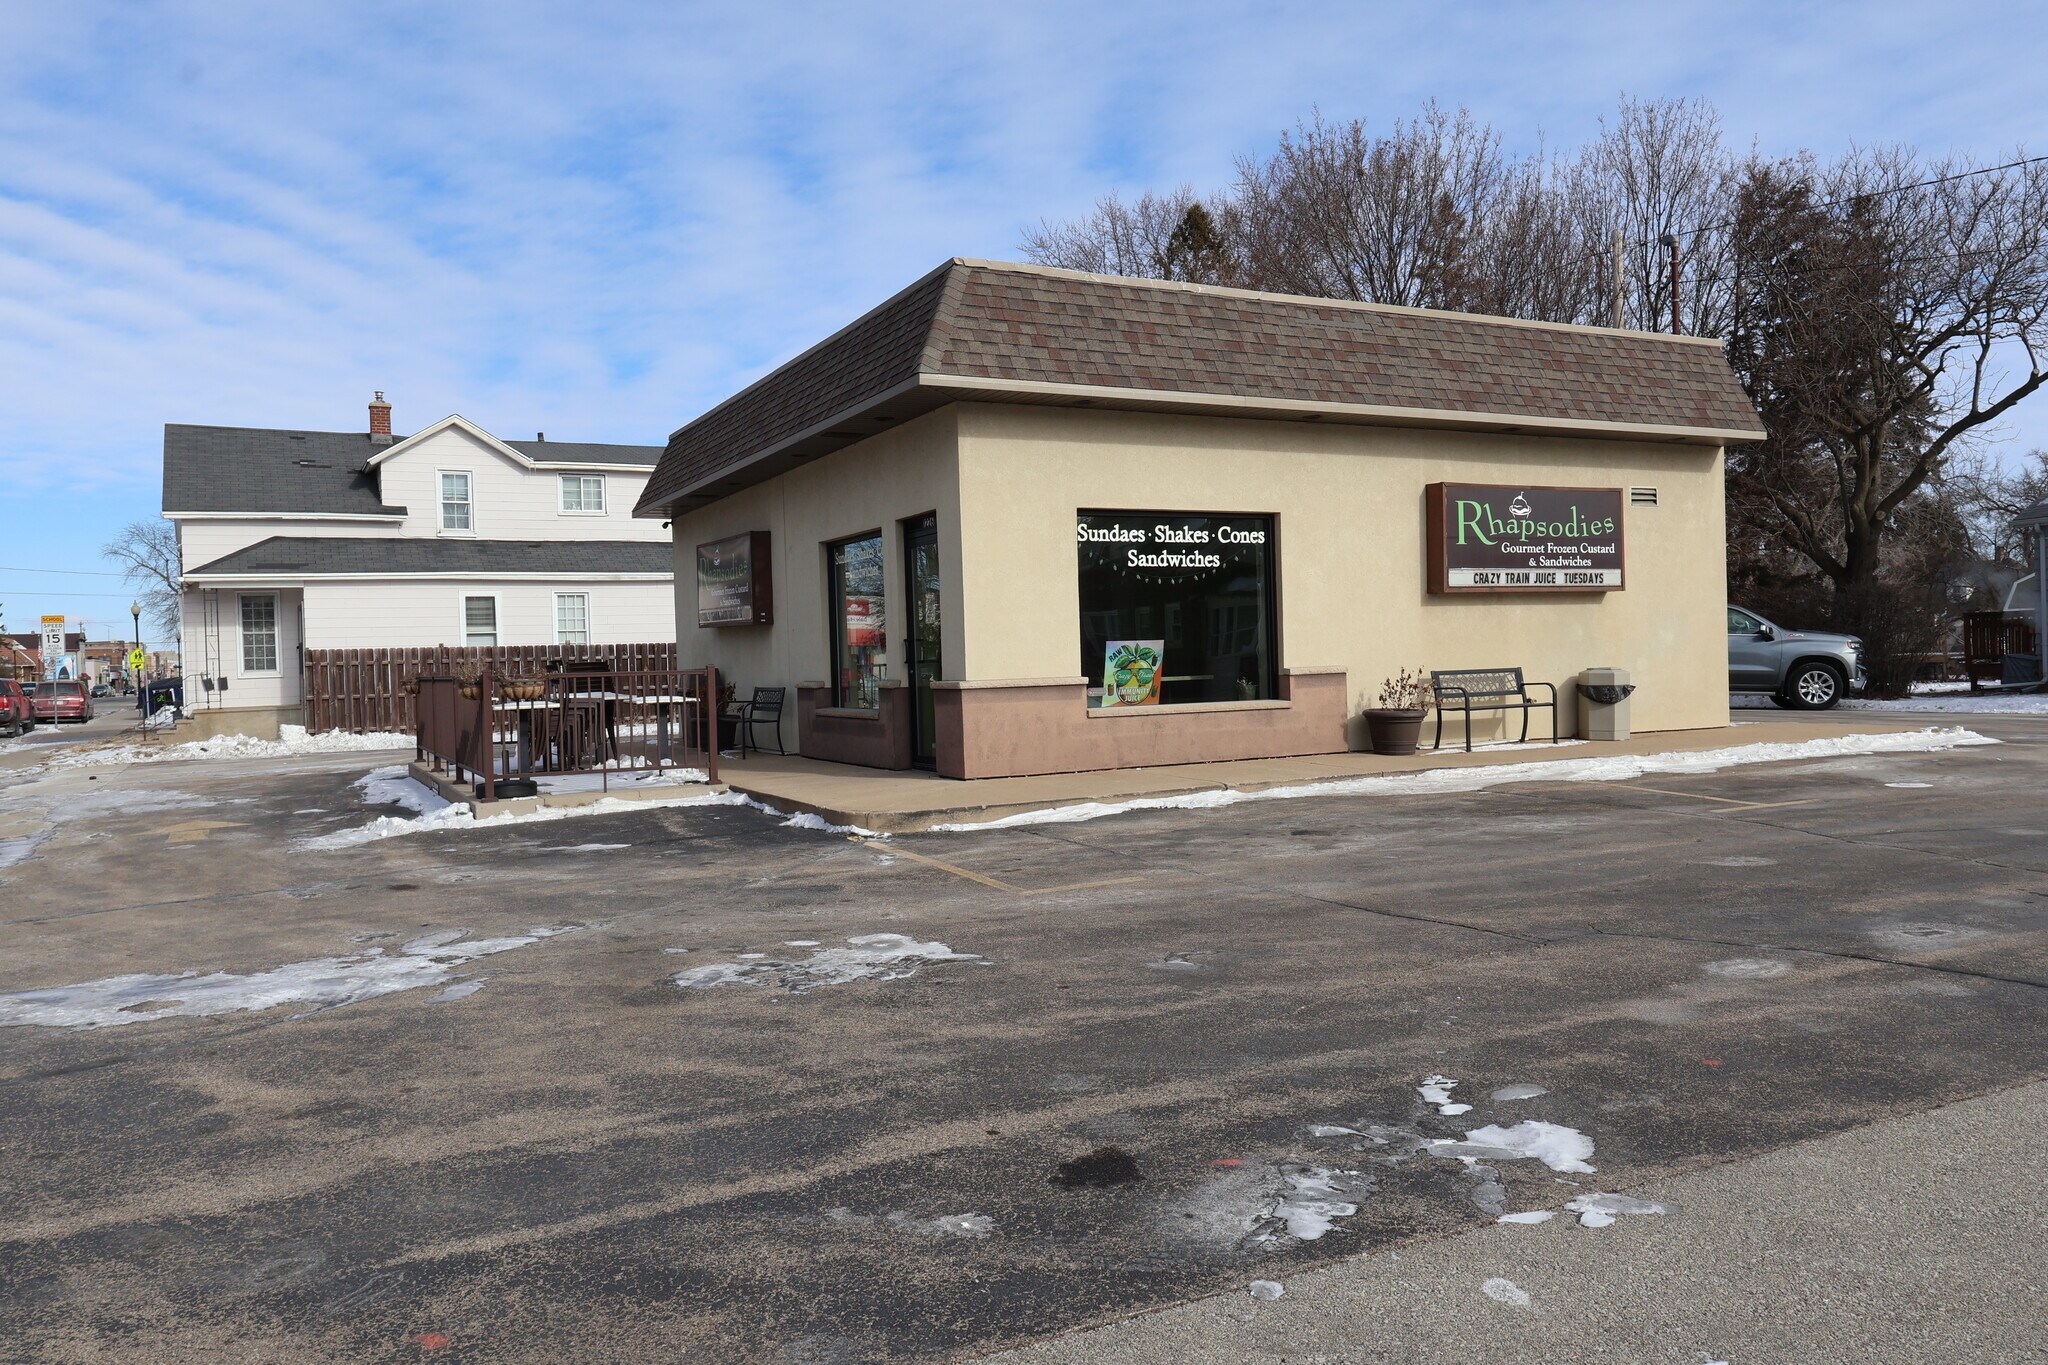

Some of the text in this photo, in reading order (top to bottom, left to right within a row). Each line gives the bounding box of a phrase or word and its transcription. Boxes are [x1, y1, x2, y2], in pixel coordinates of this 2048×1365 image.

[1455, 500, 1615, 546] Rhapsodies
[1077, 523, 1265, 544] Sundaes Shakes Cones
[1501, 542, 1615, 554] Gourmet Frozen Custard
[1127, 549, 1220, 568] Sandwiches
[1529, 556, 1592, 567] & Sandwiches
[1473, 572, 1604, 584] CRAZY TRAIN JUICE TUESDAYS
[46, 634, 60, 643] 15
[1108, 648, 1123, 662] RAW
[1118, 686, 1149, 695] IMMUNITY
